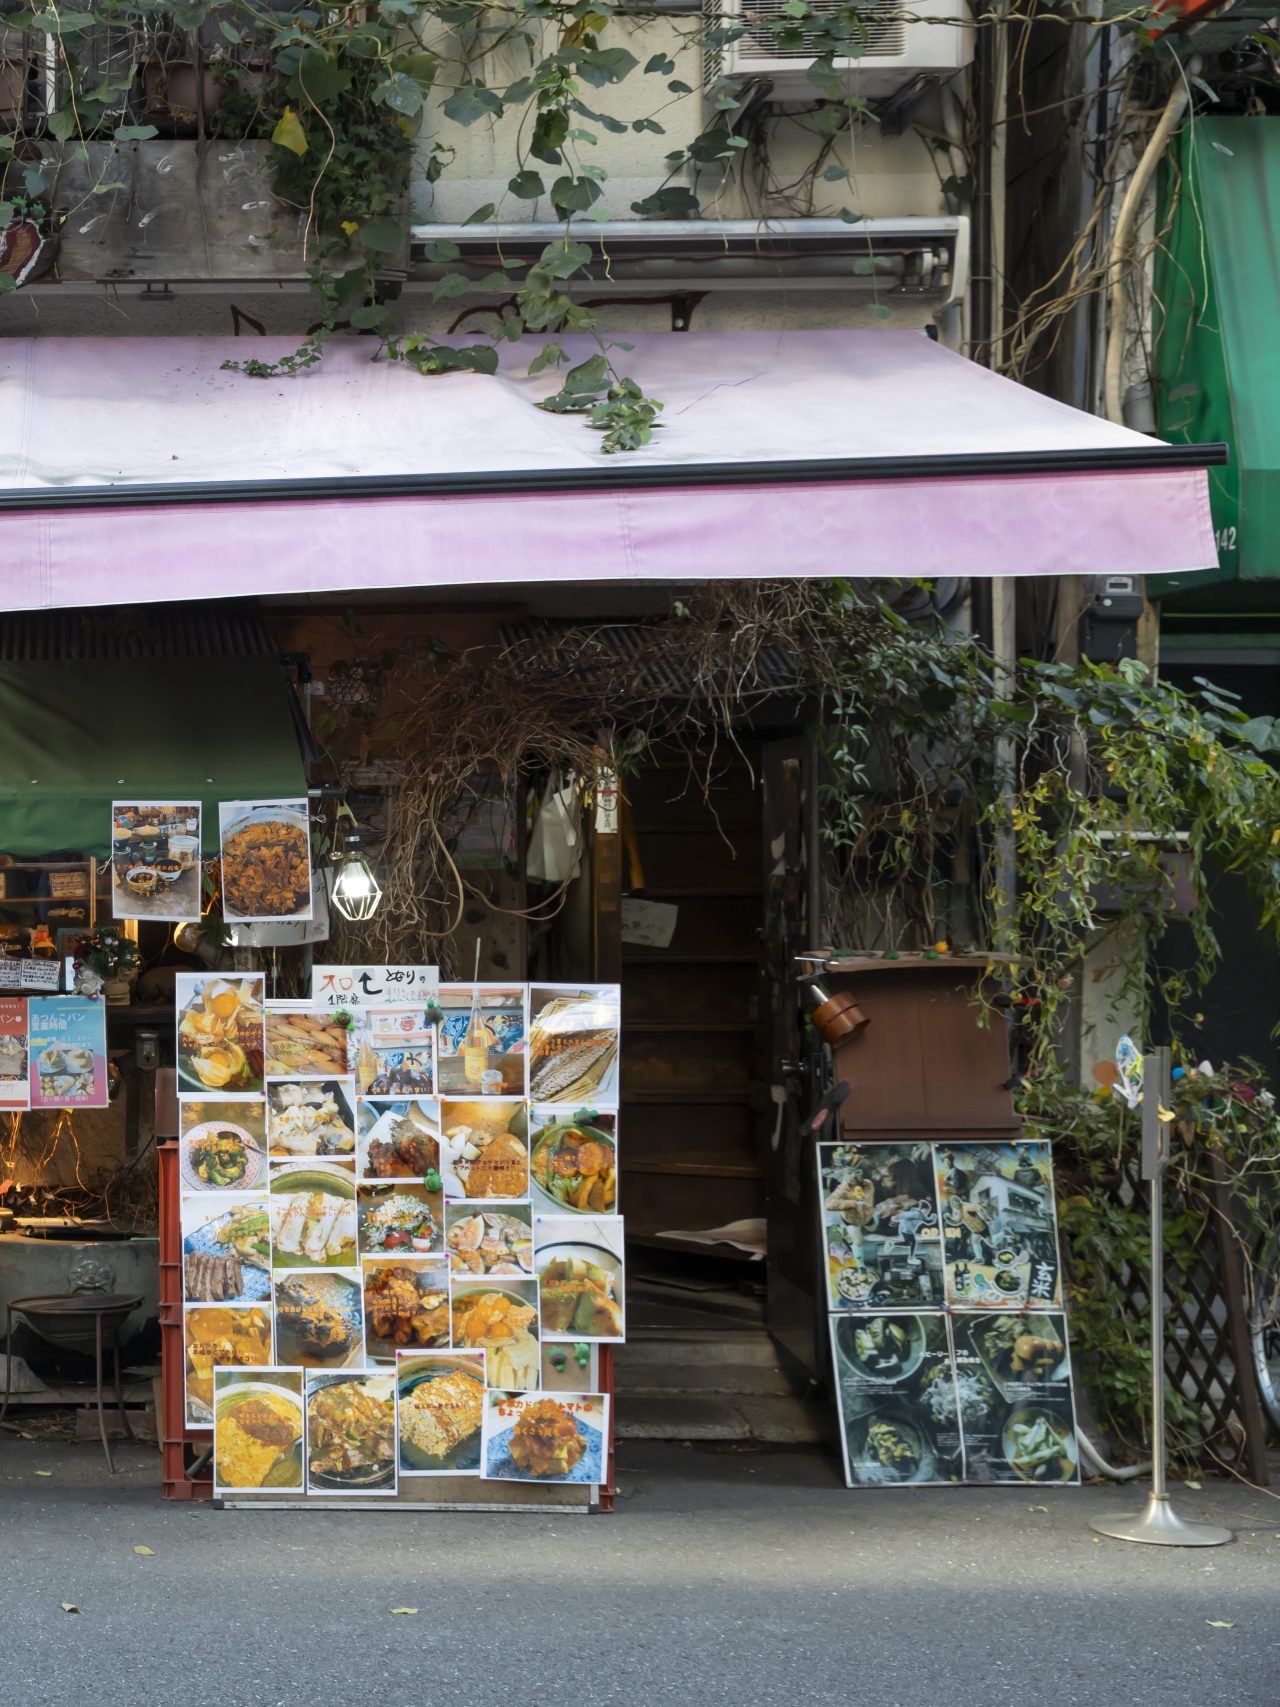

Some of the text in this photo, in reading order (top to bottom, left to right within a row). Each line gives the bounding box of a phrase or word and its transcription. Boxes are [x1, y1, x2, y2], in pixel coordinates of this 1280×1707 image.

[319, 975, 353, 993] 入口
[385, 968, 426, 985] となりの
[328, 993, 360, 1006] 1階席
[1031, 1261, 1056, 1299] 玄米
